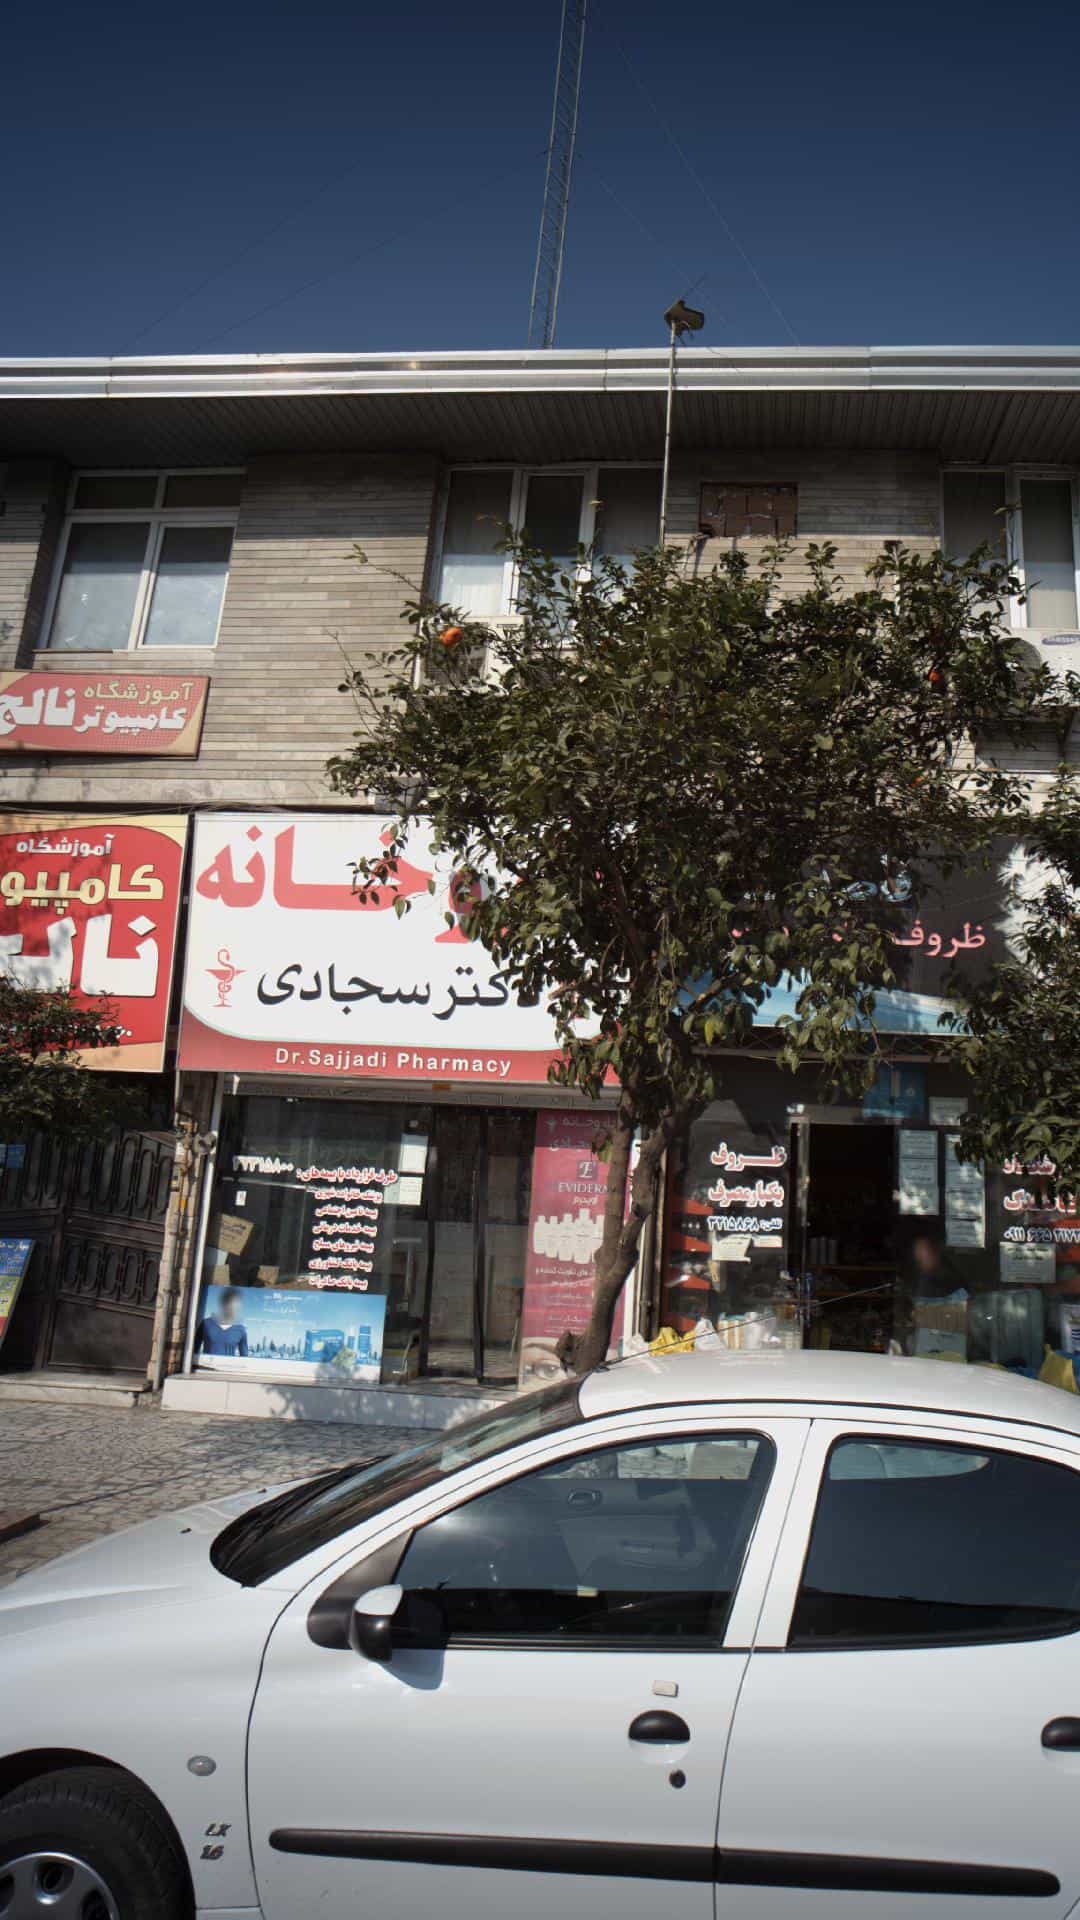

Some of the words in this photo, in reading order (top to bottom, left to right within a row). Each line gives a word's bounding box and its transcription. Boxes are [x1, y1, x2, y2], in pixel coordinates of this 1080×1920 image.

[84, 680, 194, 705] آموزشگاه
[74, 705, 187, 735] کامپیوتر
[16, 834, 115, 857] آموزشگاه
[195, 824, 510, 944] وخانه
[894, 919, 986, 958] ظروف
[257, 963, 431, 1016] سجادی
[397, 1052, 512, 1077] Pharmacy
[711, 1142, 787, 1171] ظروف
